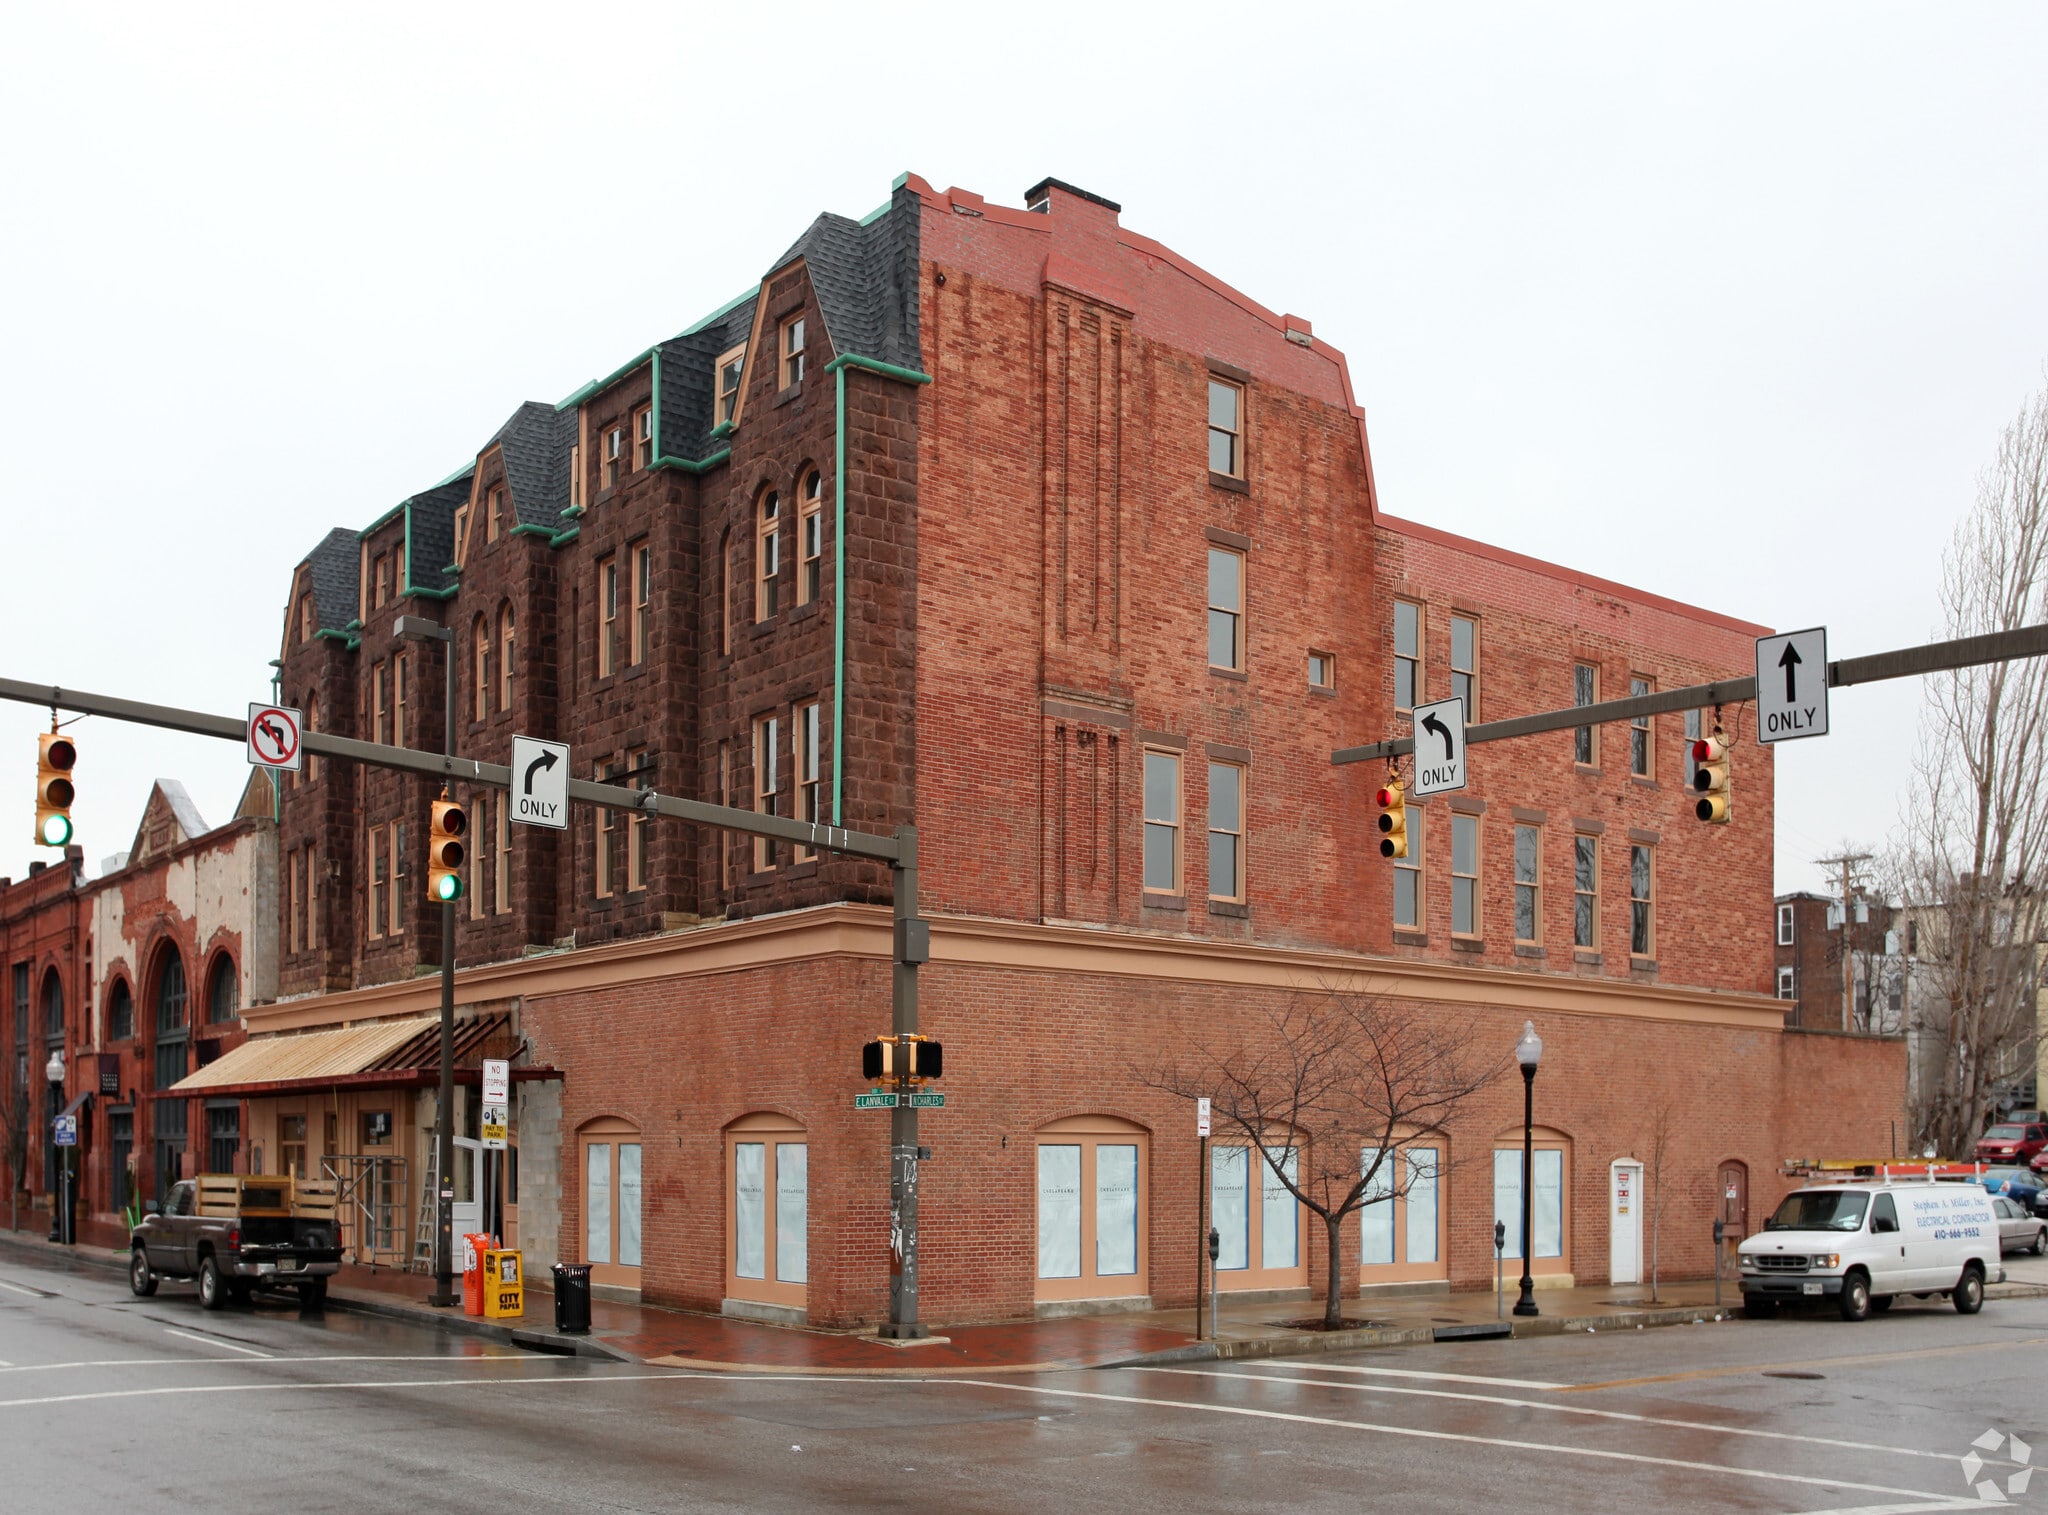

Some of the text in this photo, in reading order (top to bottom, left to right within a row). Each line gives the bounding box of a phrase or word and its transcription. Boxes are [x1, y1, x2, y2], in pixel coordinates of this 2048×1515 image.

[1768, 707, 1816, 733] ONLY
[1422, 764, 1456, 786] ONLY
[520, 798, 558, 819] ONLY
[491, 1066, 501, 1074] NO
[485, 1078, 506, 1087] STOPPING
[855, 1097, 860, 1107] E
[861, 1096, 889, 1107] LANVALE
[917, 1096, 939, 1105] CHARLES
[1913, 1199, 1939, 1214] Stephen
[1917, 1212, 1990, 1227] ELECTRICAL CONTRACTOR
[1934, 1227, 1980, 1240] 410-666-9552
[499, 1293, 519, 1303] CITY
